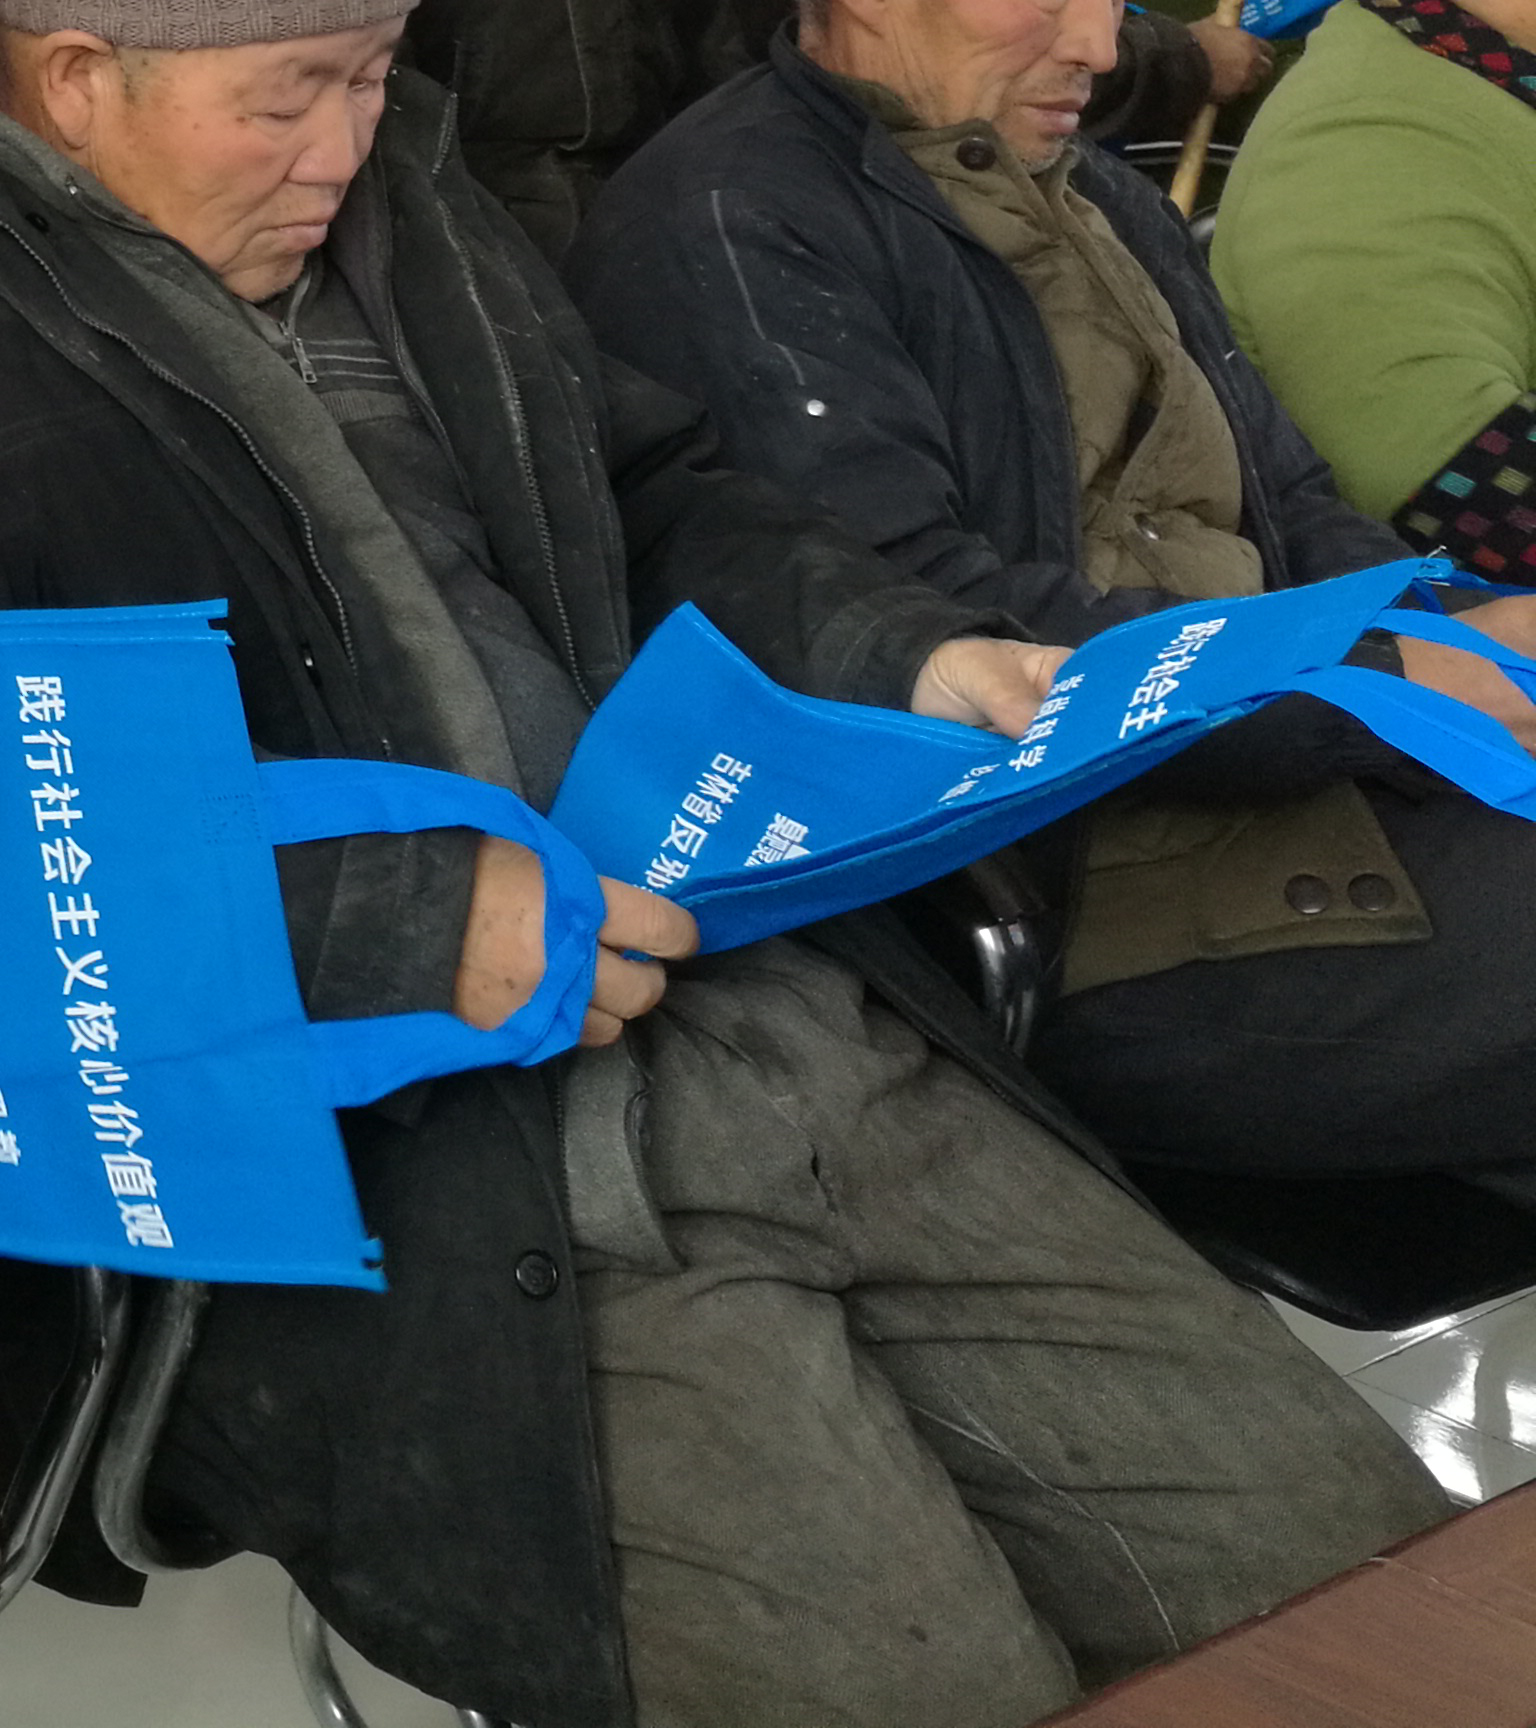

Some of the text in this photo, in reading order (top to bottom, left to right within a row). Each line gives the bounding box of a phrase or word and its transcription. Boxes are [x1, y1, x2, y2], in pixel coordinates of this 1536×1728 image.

[14, 675, 174, 1249] 践行社会主义核心价值观
